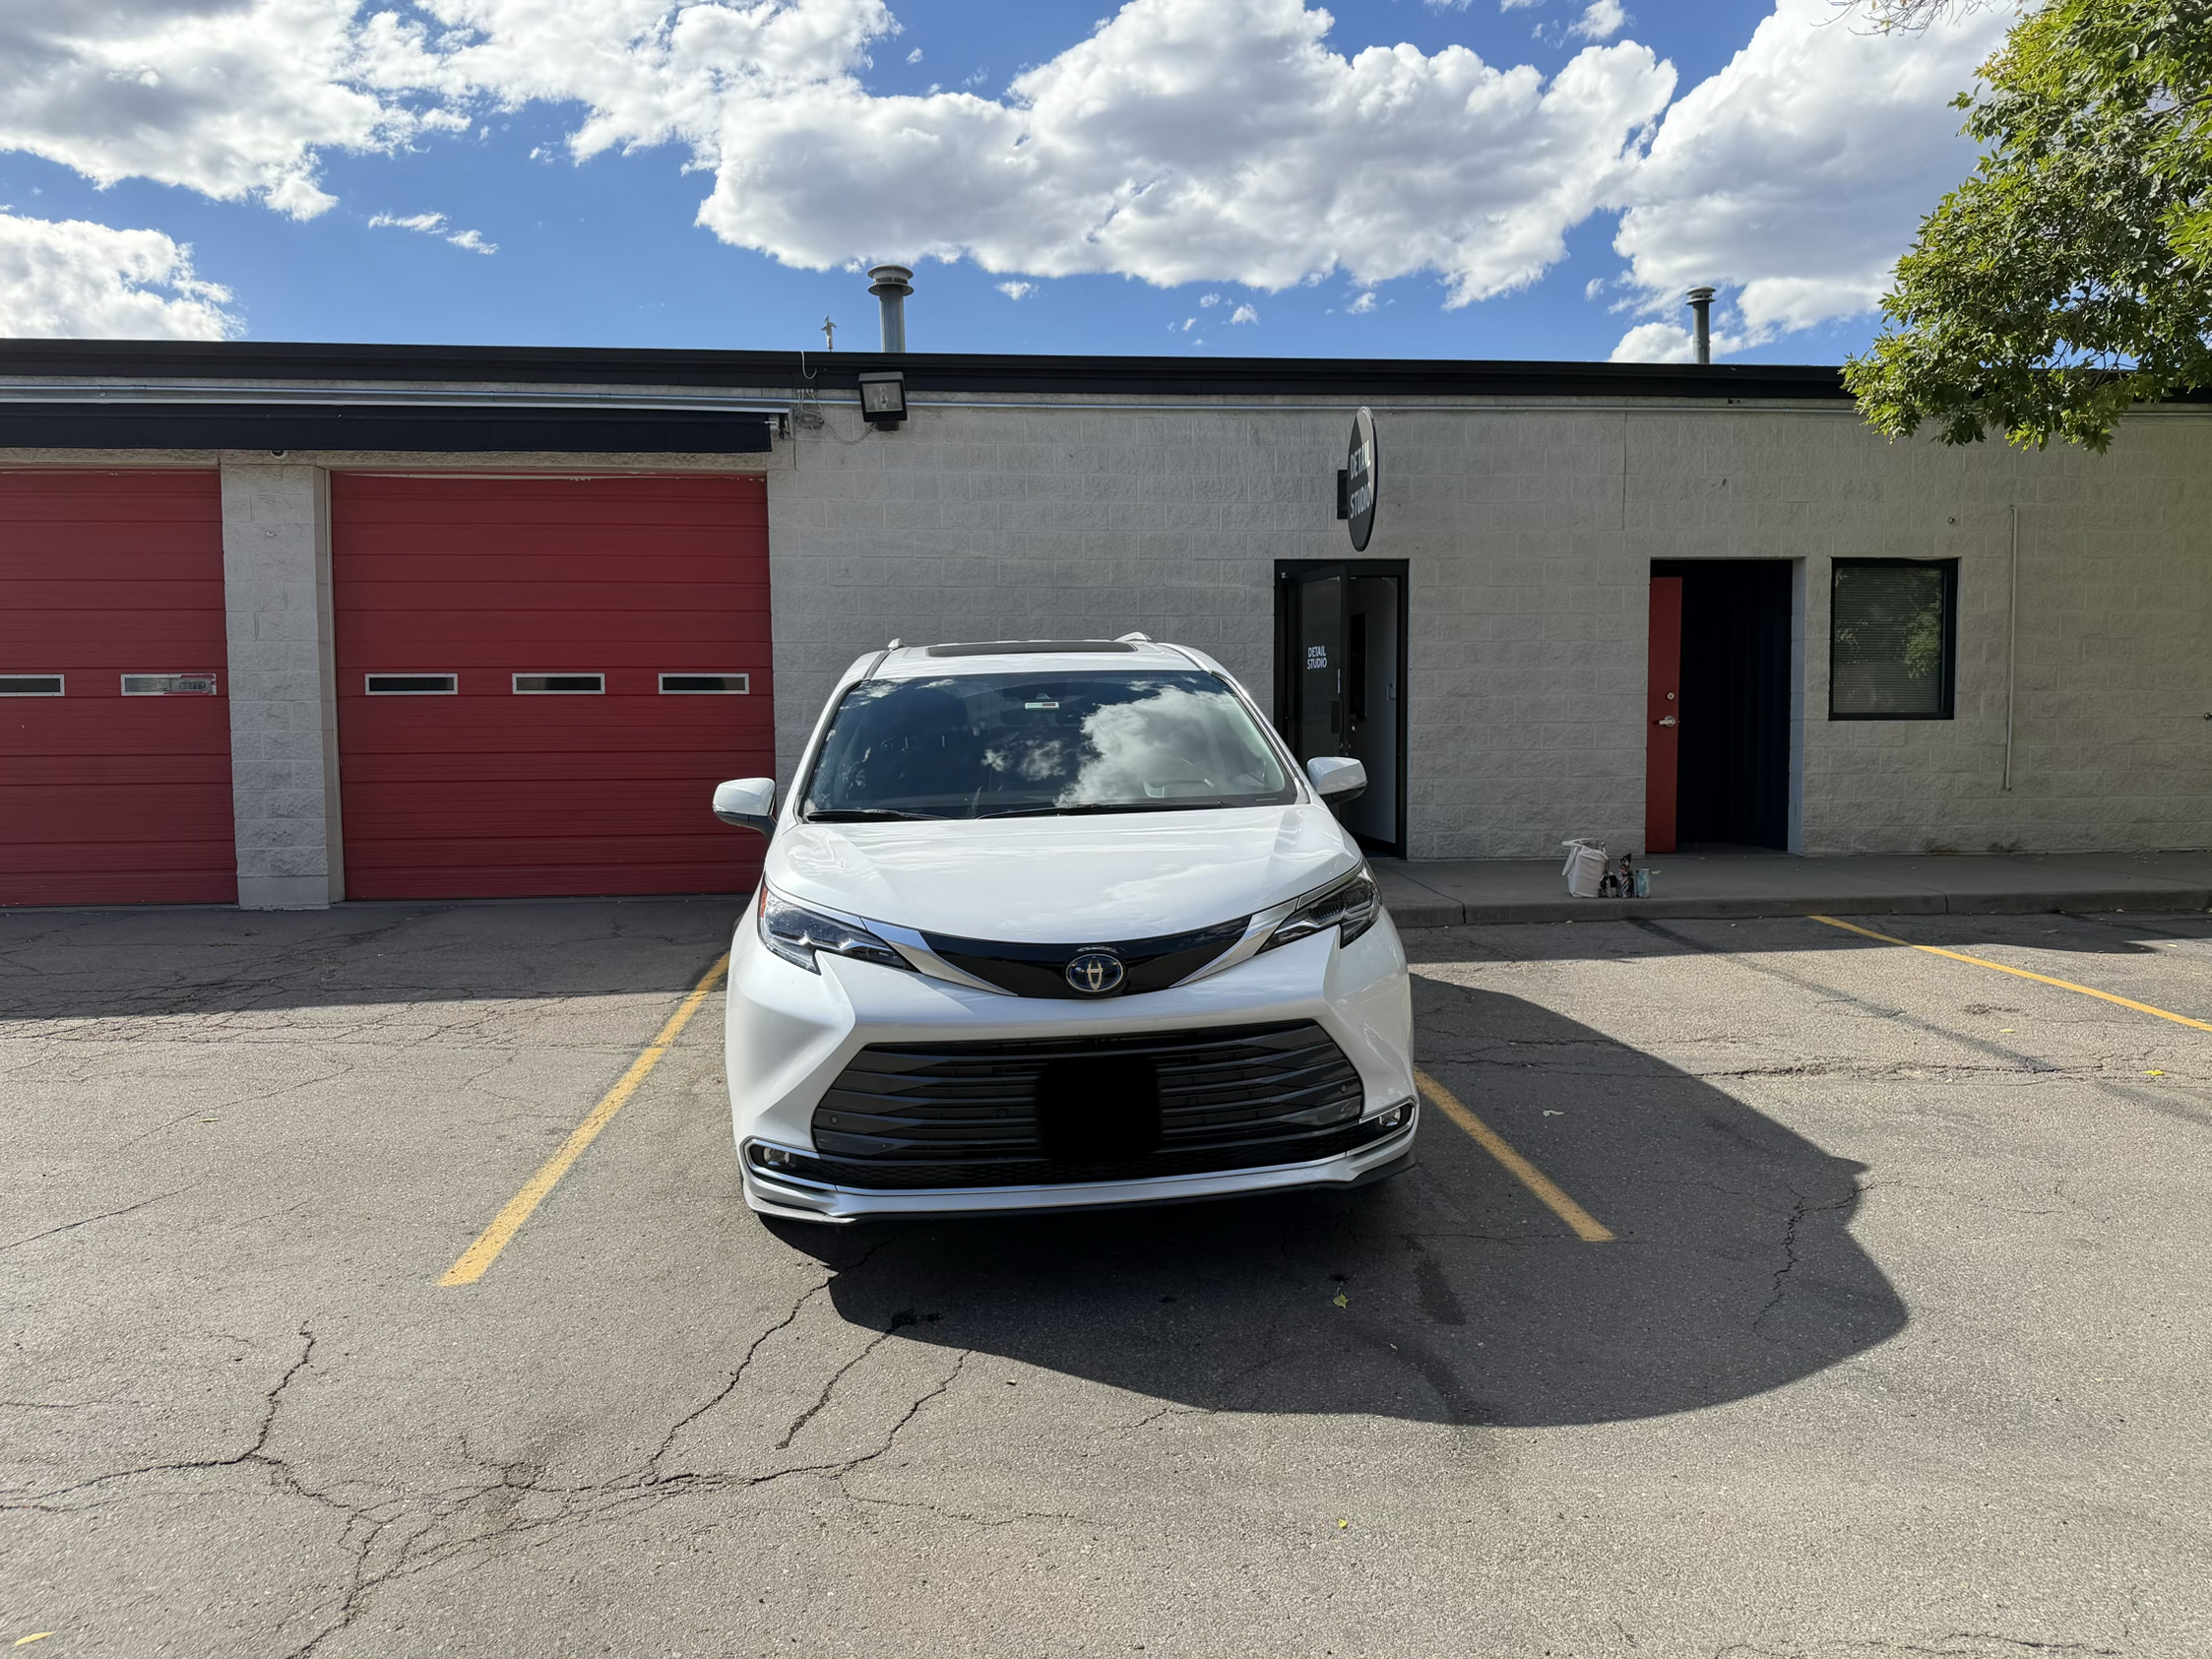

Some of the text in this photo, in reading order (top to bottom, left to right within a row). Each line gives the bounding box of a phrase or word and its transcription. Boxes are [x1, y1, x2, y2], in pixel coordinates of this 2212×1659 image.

[1350, 439, 1371, 480] DETAIL
[1350, 480, 1371, 520] STUDIO
[1306, 657, 1328, 670] STUDIO
[1307, 645, 1327, 658] DETAIL
